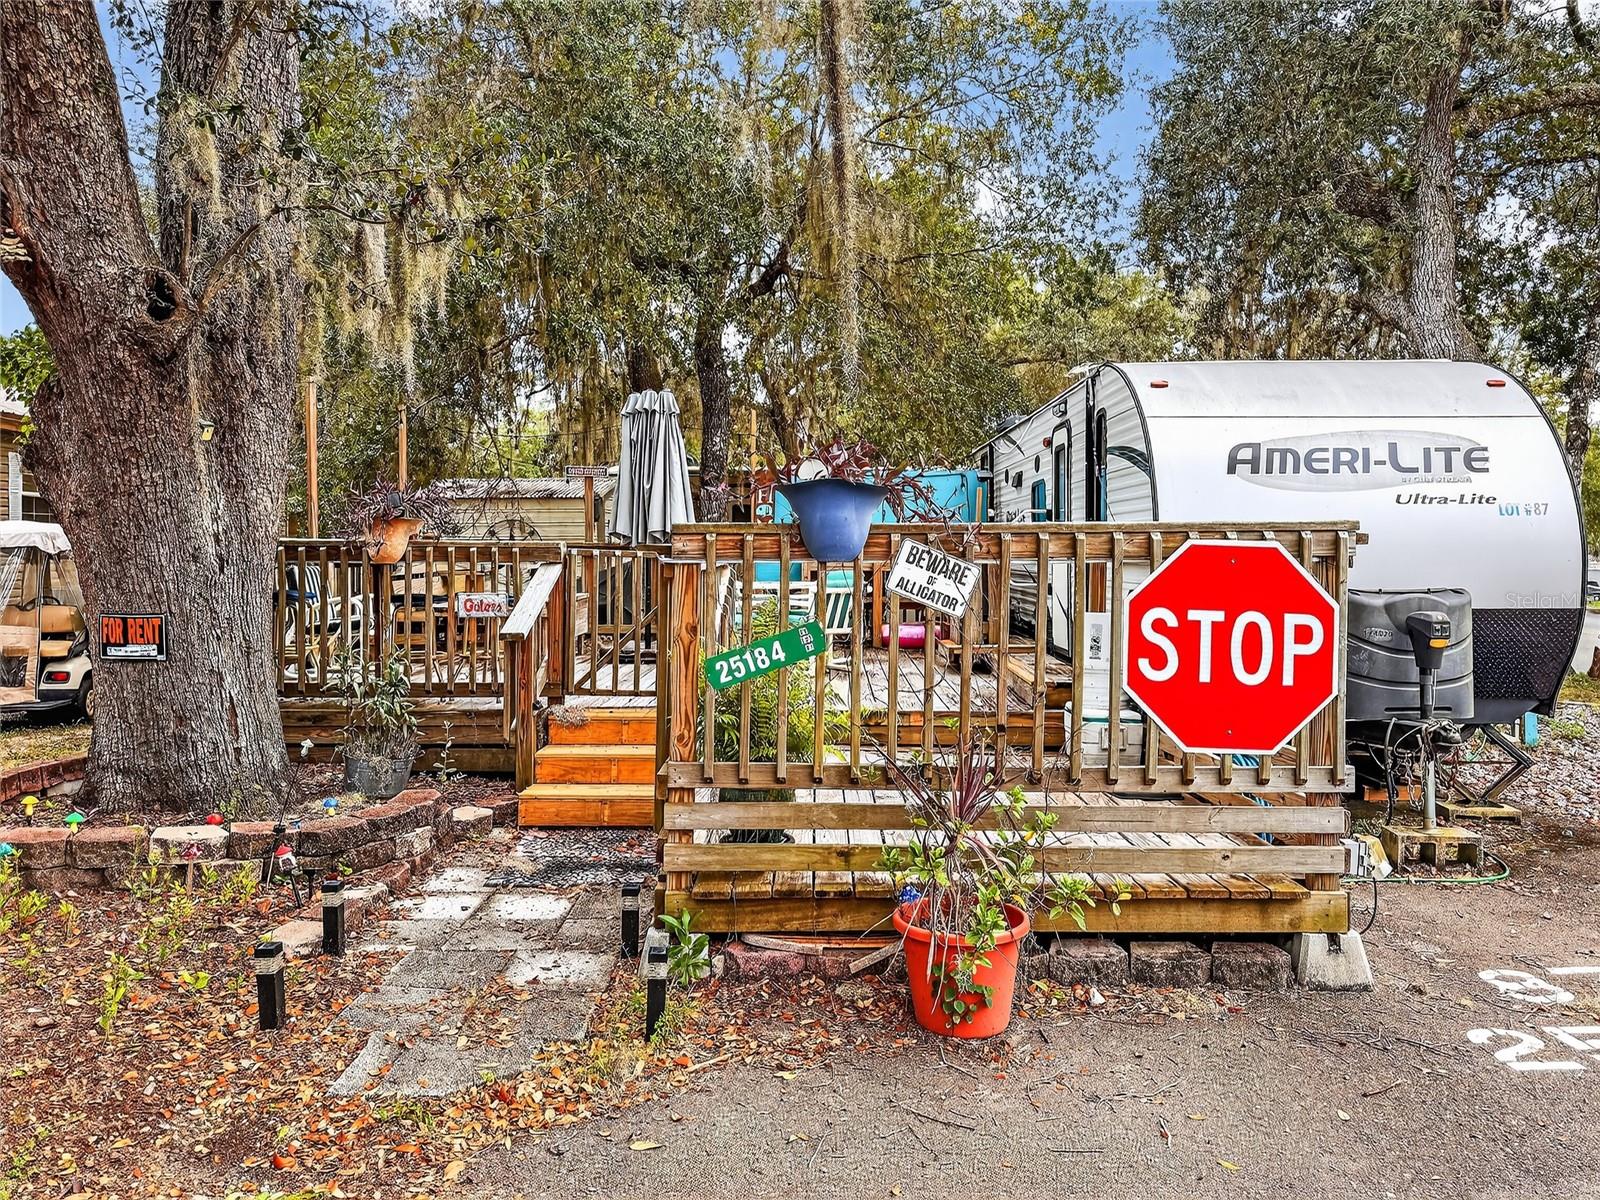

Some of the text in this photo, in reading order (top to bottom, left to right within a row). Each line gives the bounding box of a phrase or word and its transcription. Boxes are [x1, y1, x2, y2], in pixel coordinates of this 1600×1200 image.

[1394, 492, 1497, 506] Ultra-Lite
[1498, 502, 1520, 516] LOT
[905, 545, 971, 587] BEWARE
[926, 575, 938, 586] OF
[895, 576, 959, 612] ALLIGATOR
[102, 616, 161, 645] FOR RENT
[1137, 606, 1325, 687] STOP
[715, 640, 786, 683] 25184
